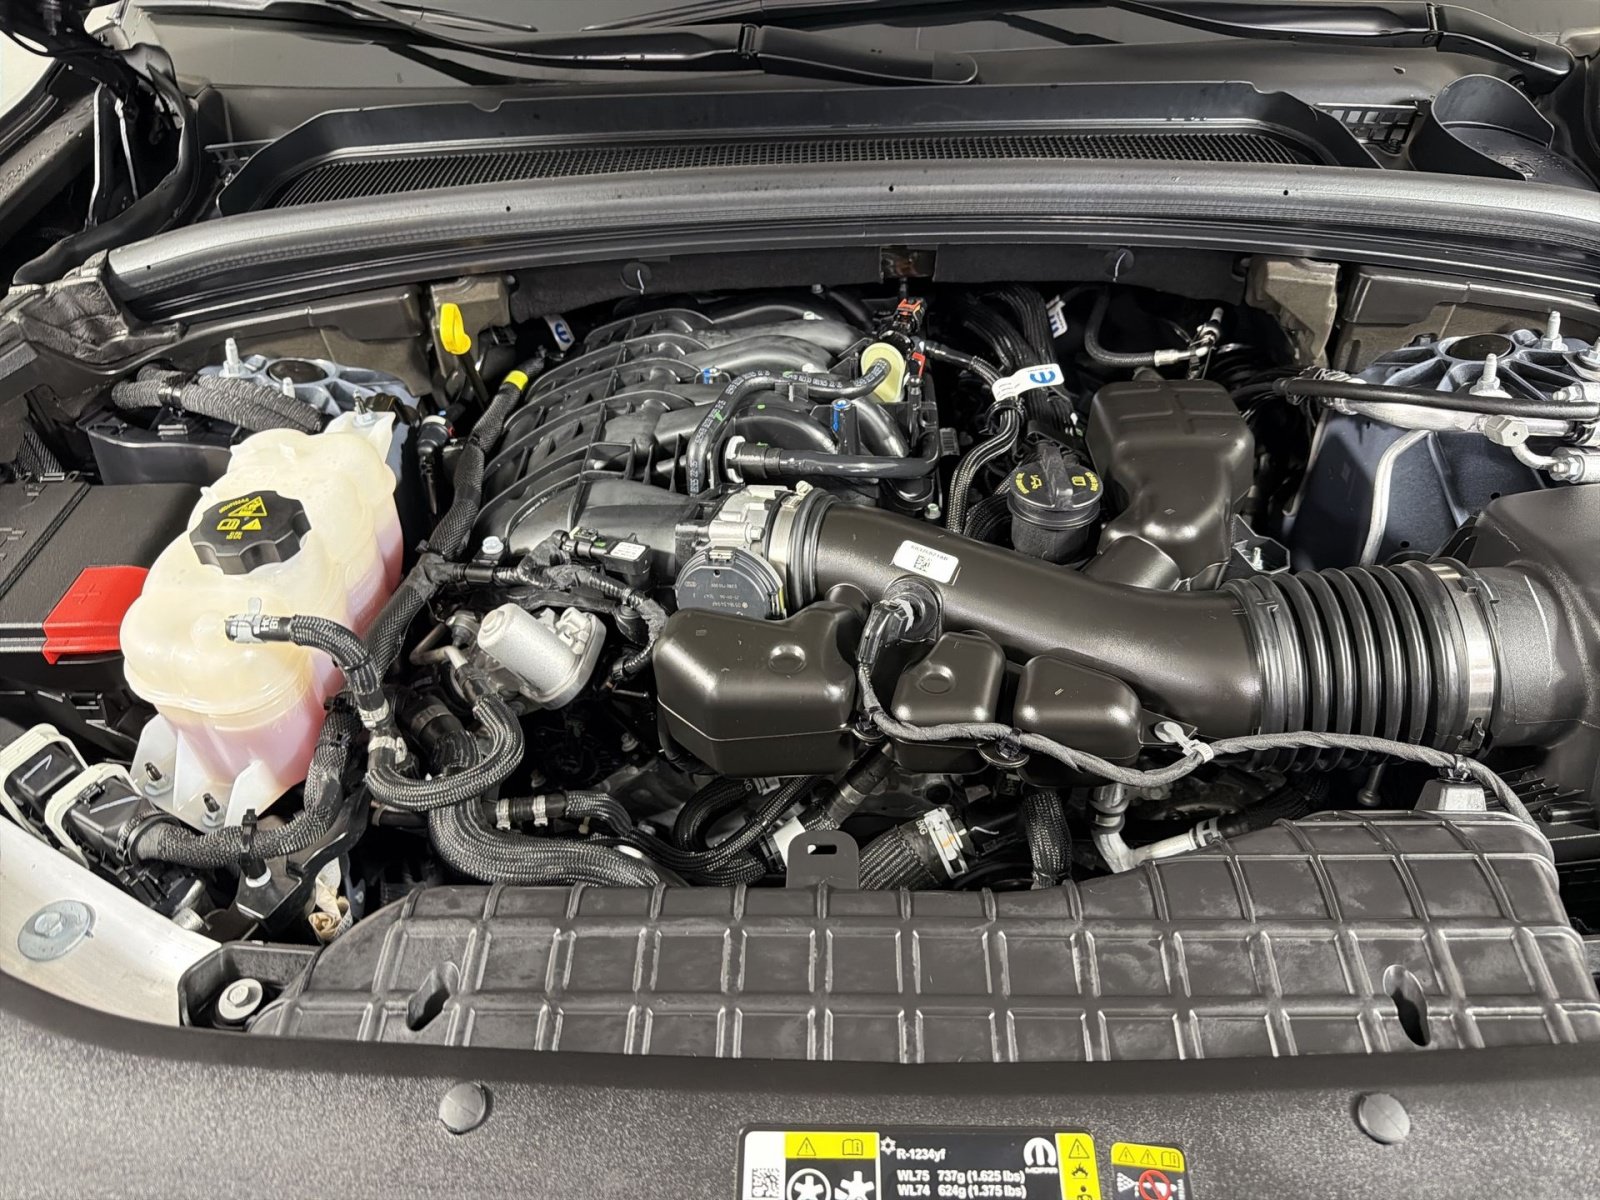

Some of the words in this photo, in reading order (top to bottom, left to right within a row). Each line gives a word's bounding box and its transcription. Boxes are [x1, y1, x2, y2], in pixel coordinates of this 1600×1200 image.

[915, 820, 928, 835] ENG
[896, 1148, 946, 1163] R-1234yf
[896, 1169, 930, 1182] WL75
[937, 1170, 966, 1184] 737g
[966, 1170, 1002, 1184] (1.625
[1002, 1170, 1026, 1184] lbs)
[897, 1184, 931, 1196] WL74
[937, 1184, 967, 1199] 624g
[967, 1184, 1003, 1199] (1.375
[1003, 1184, 1027, 1199] lbs)
